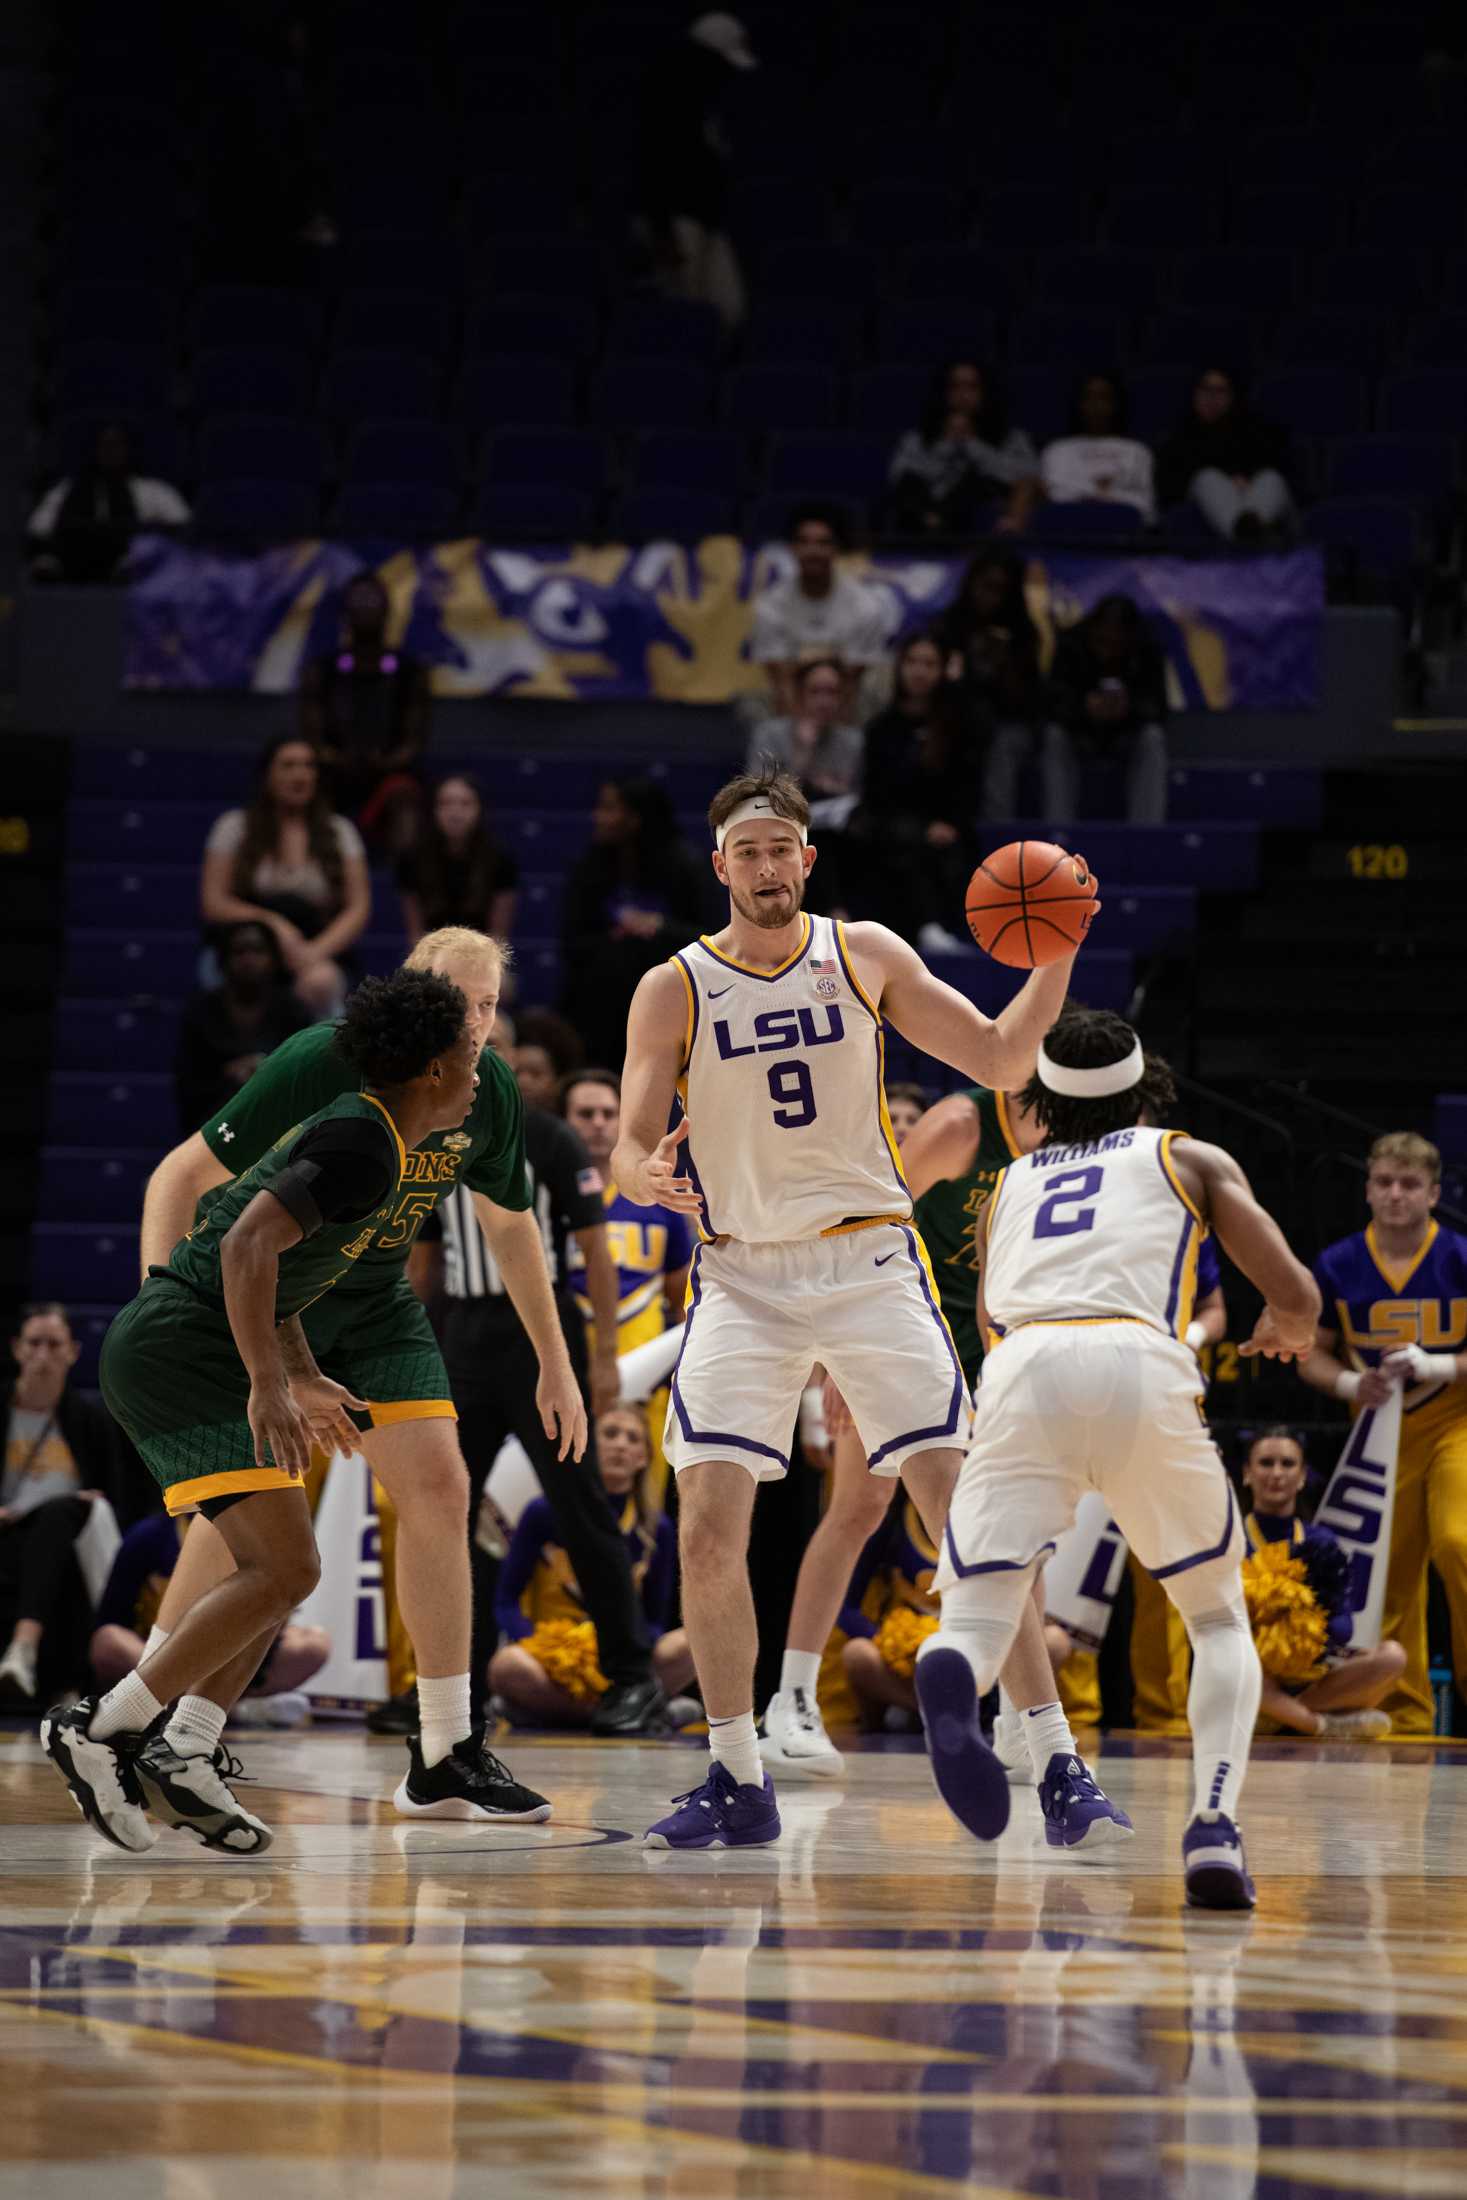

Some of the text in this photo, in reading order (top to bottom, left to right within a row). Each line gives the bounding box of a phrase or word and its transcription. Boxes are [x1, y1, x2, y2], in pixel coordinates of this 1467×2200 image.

[1344, 842, 1407, 880] 120
[713, 1004, 845, 1060] LSU
[767, 1060, 817, 1129] 9
[1031, 1131, 1135, 1168] WILLIAMS
[1033, 1165, 1104, 1239] 2
[1335, 1296, 1467, 1350] LSU
